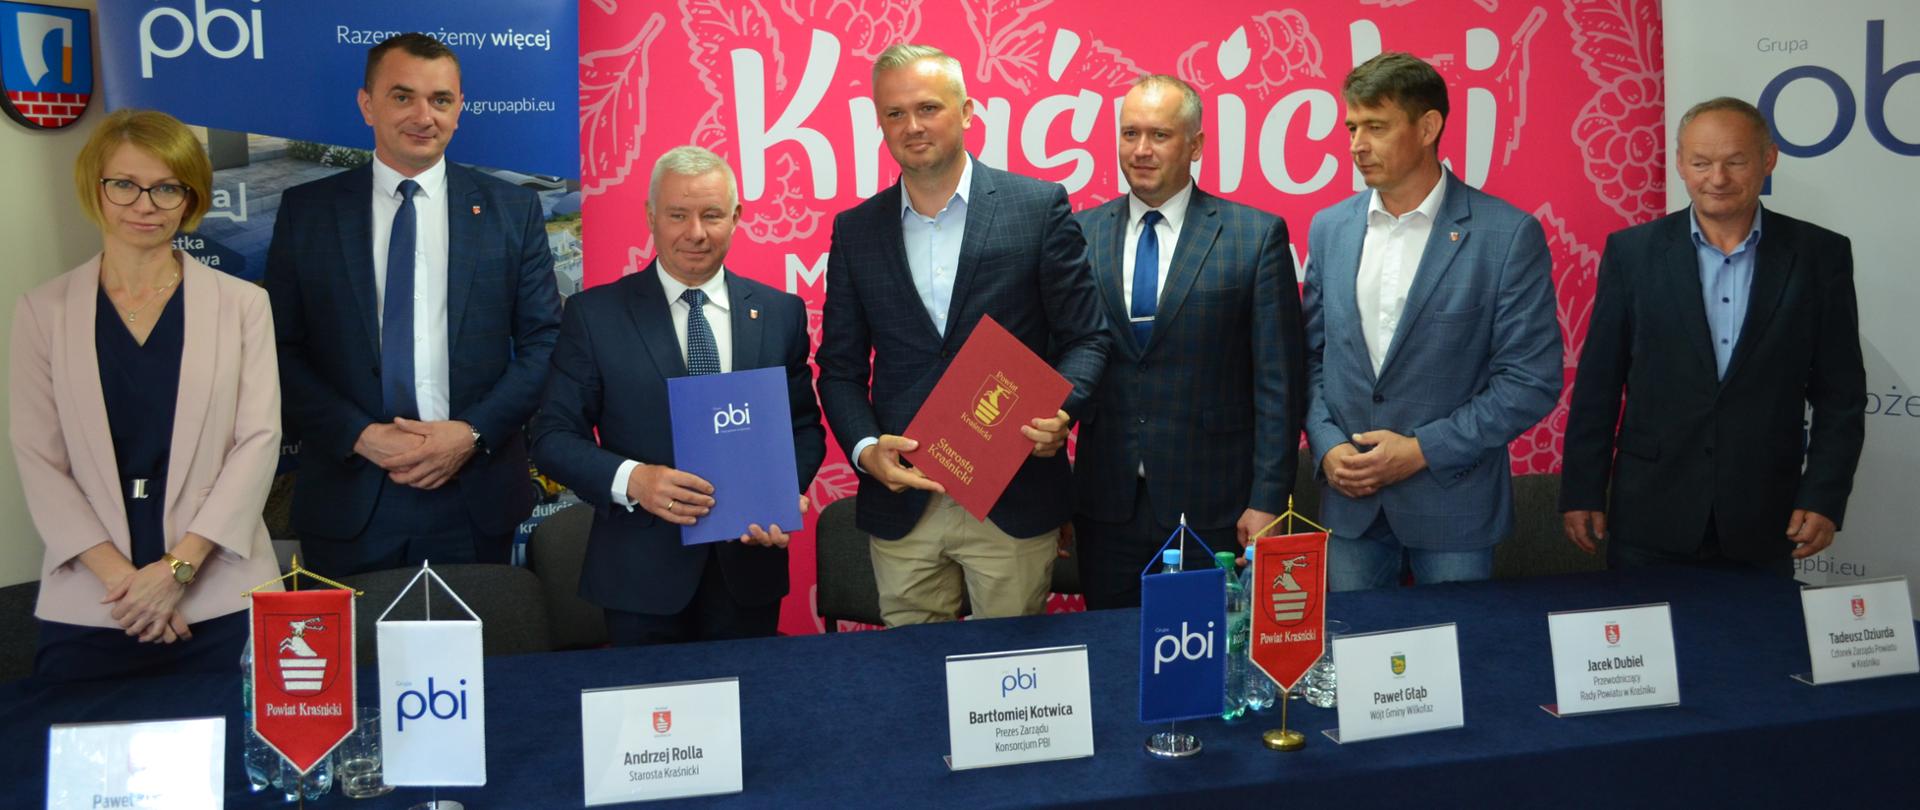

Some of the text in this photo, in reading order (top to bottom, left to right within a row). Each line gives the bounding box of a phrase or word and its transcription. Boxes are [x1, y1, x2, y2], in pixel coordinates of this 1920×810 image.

[139, 0, 264, 78] pbi
[417, 27, 486, 49] ożemy
[491, 28, 551, 51] więcej
[1757, 37, 1808, 54] Grupa
[460, 98, 556, 115] w.grupapbi.eu
[1757, 19, 1920, 195] pb
[171, 236, 205, 250] stka
[996, 371, 1018, 392] Powiat
[714, 402, 750, 434] pbi
[927, 443, 973, 486] Kraśnicki
[937, 438, 974, 473] Starosta
[1793, 556, 1865, 577] apbi.eu
[1260, 632, 1283, 645] Powiat
[1829, 626, 1895, 644] Tadeusz Dziurda
[1154, 621, 1214, 674] pbi
[1588, 654, 1644, 672] Jacek Dubiel
[1002, 667, 1037, 698] pbi
[397, 677, 467, 732] pbi
[1374, 685, 1427, 704] Paweł Głąb
[266, 702, 296, 716] Powiat
[969, 703, 1073, 725] Bartłomiej Kotwica
[1385, 706, 1405, 718] Gminy
[995, 723, 1048, 738] Prezes Zarządu
[624, 745, 703, 766] Andrzej Rolla
[995, 737, 1050, 753] Konsorcjum PBI
[629, 764, 699, 782] Starosta Kraśnicki
